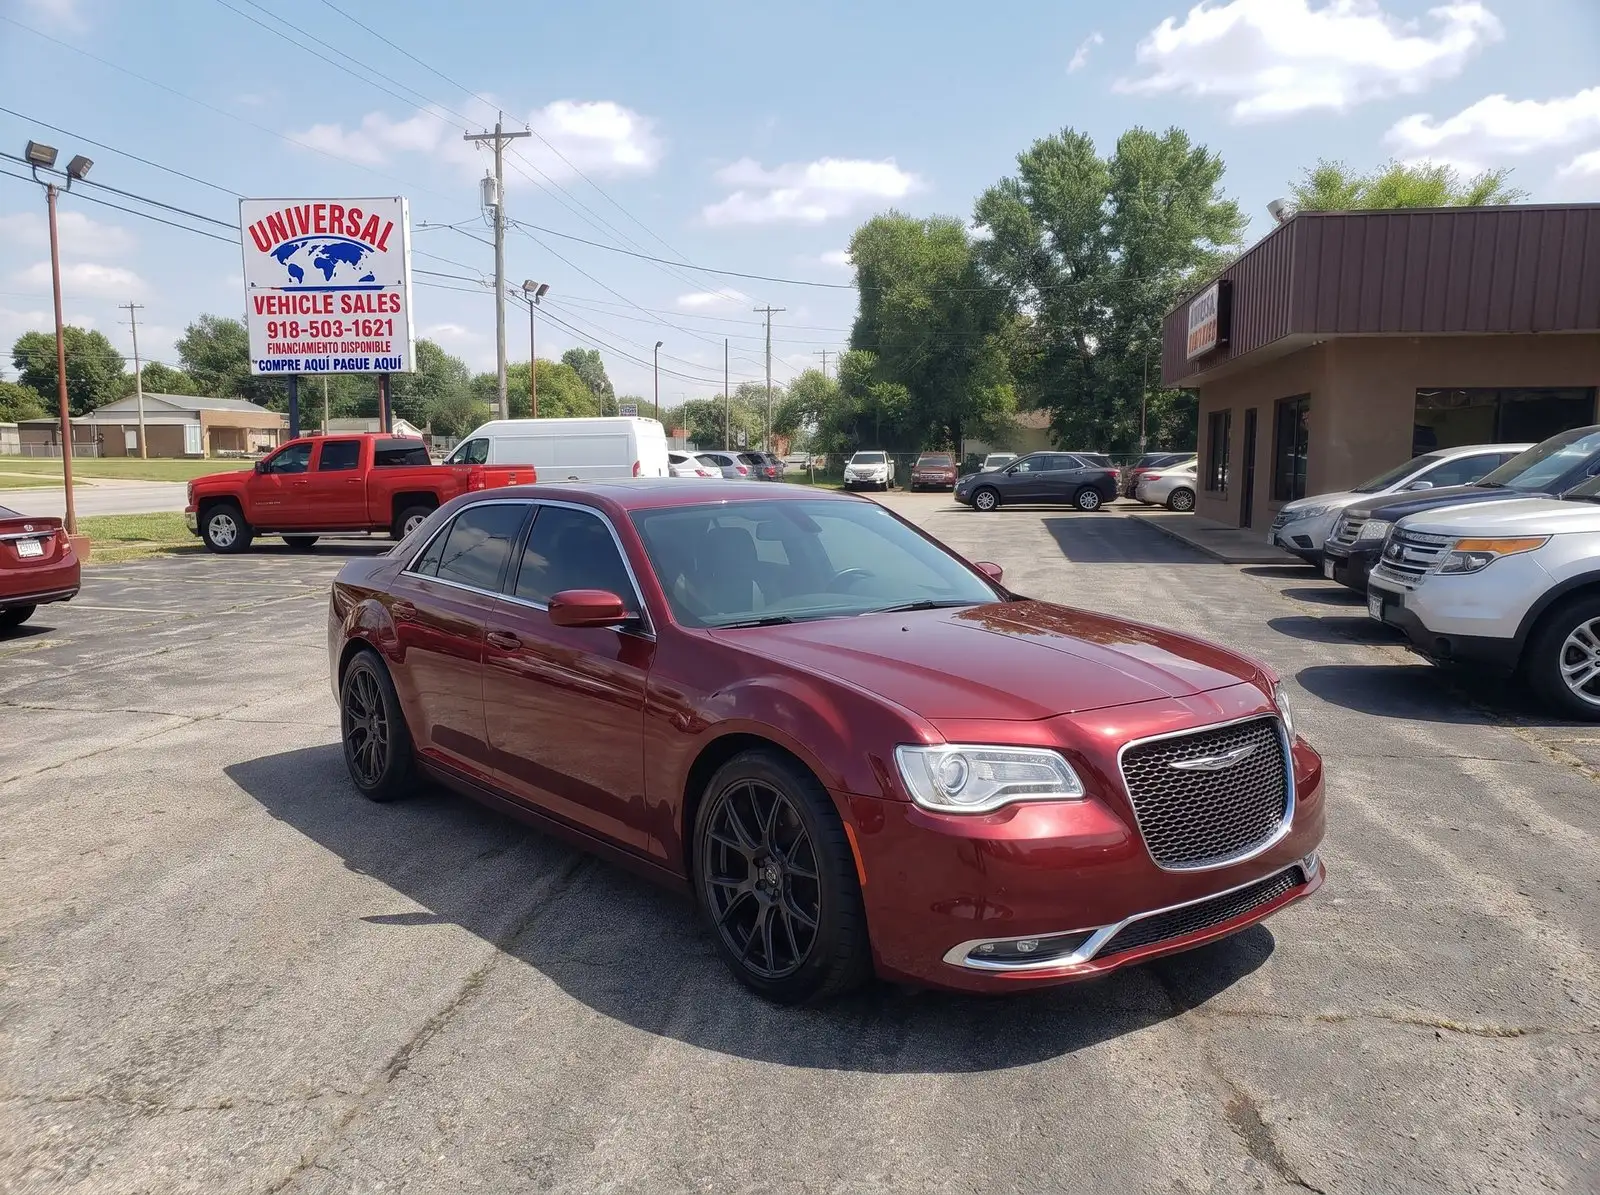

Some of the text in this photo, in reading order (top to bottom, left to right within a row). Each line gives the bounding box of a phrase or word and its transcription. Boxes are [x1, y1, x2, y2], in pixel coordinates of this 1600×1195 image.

[248, 204, 394, 253] UNIVERSAL
[254, 293, 401, 315] VEHICLE SALES
[267, 318, 393, 339] 918-503-1621
[267, 340, 391, 355] FINANCIAMIENTO DISPONIBLE
[259, 354, 402, 371] COMPRE AQUÍ PAGUE AQUÍ
